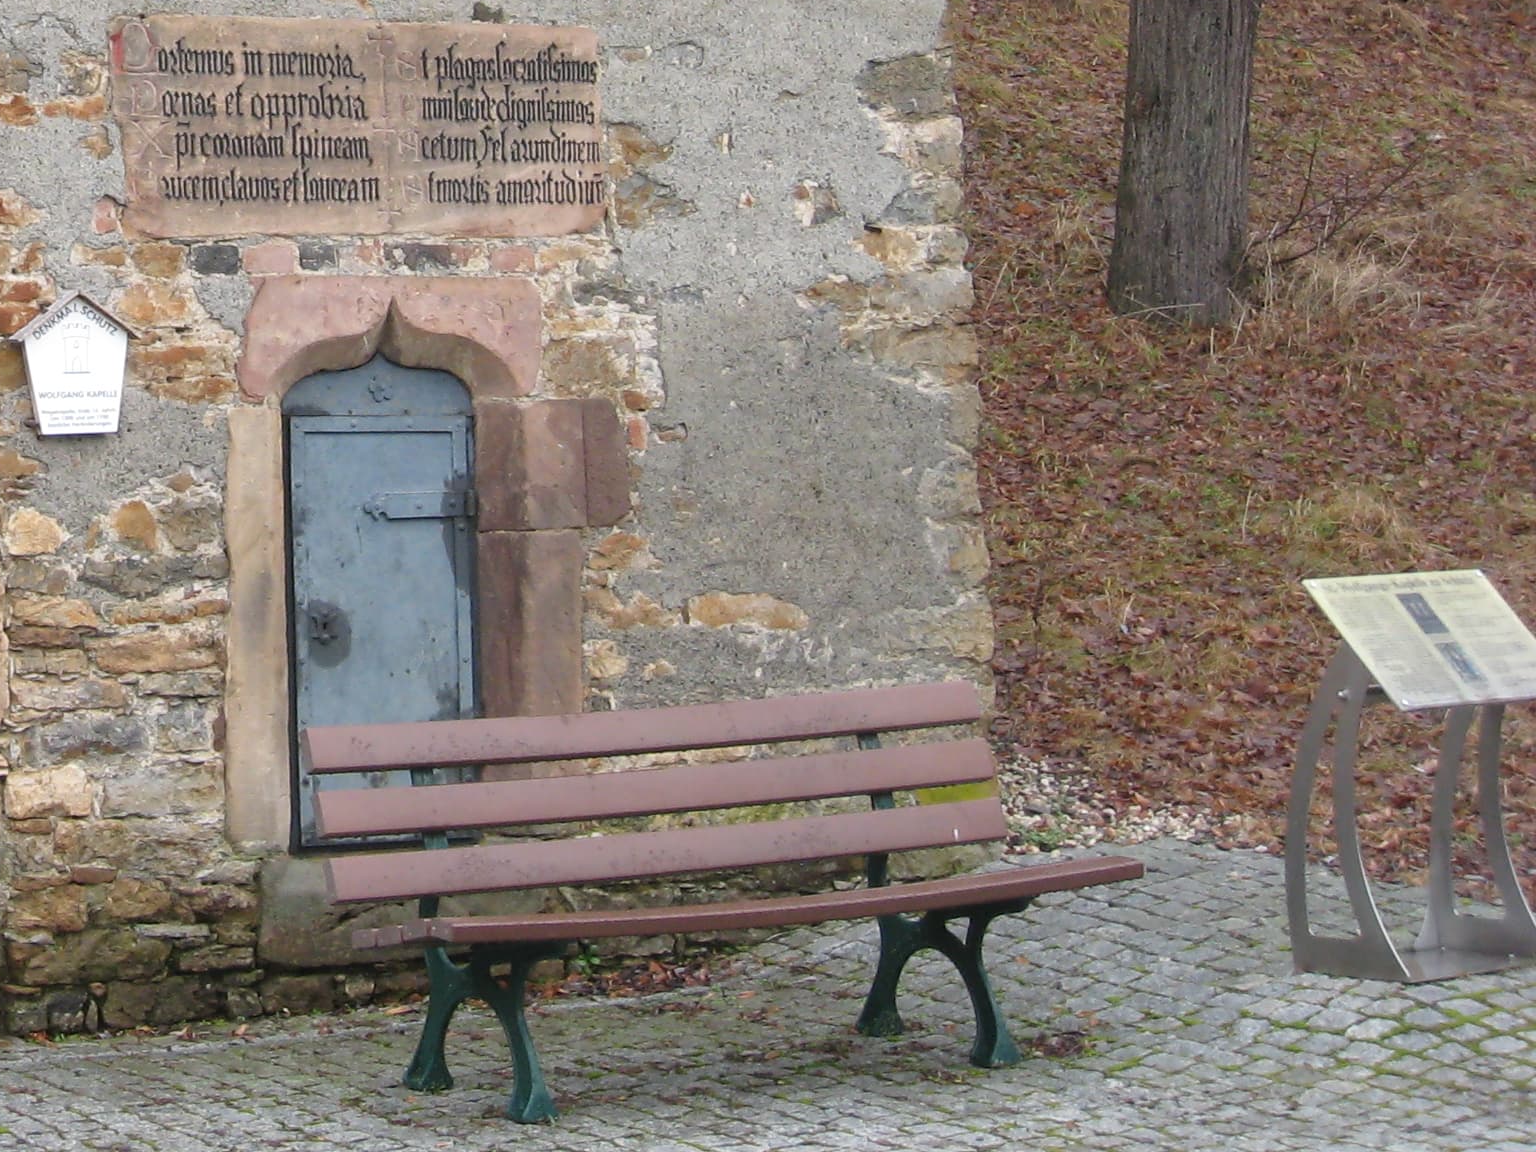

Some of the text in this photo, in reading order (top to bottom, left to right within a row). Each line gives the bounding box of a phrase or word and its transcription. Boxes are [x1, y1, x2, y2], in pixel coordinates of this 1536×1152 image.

[242, 41, 263, 76] in
[225, 81, 244, 117] et
[38, 391, 84, 399] WOLFGANG
